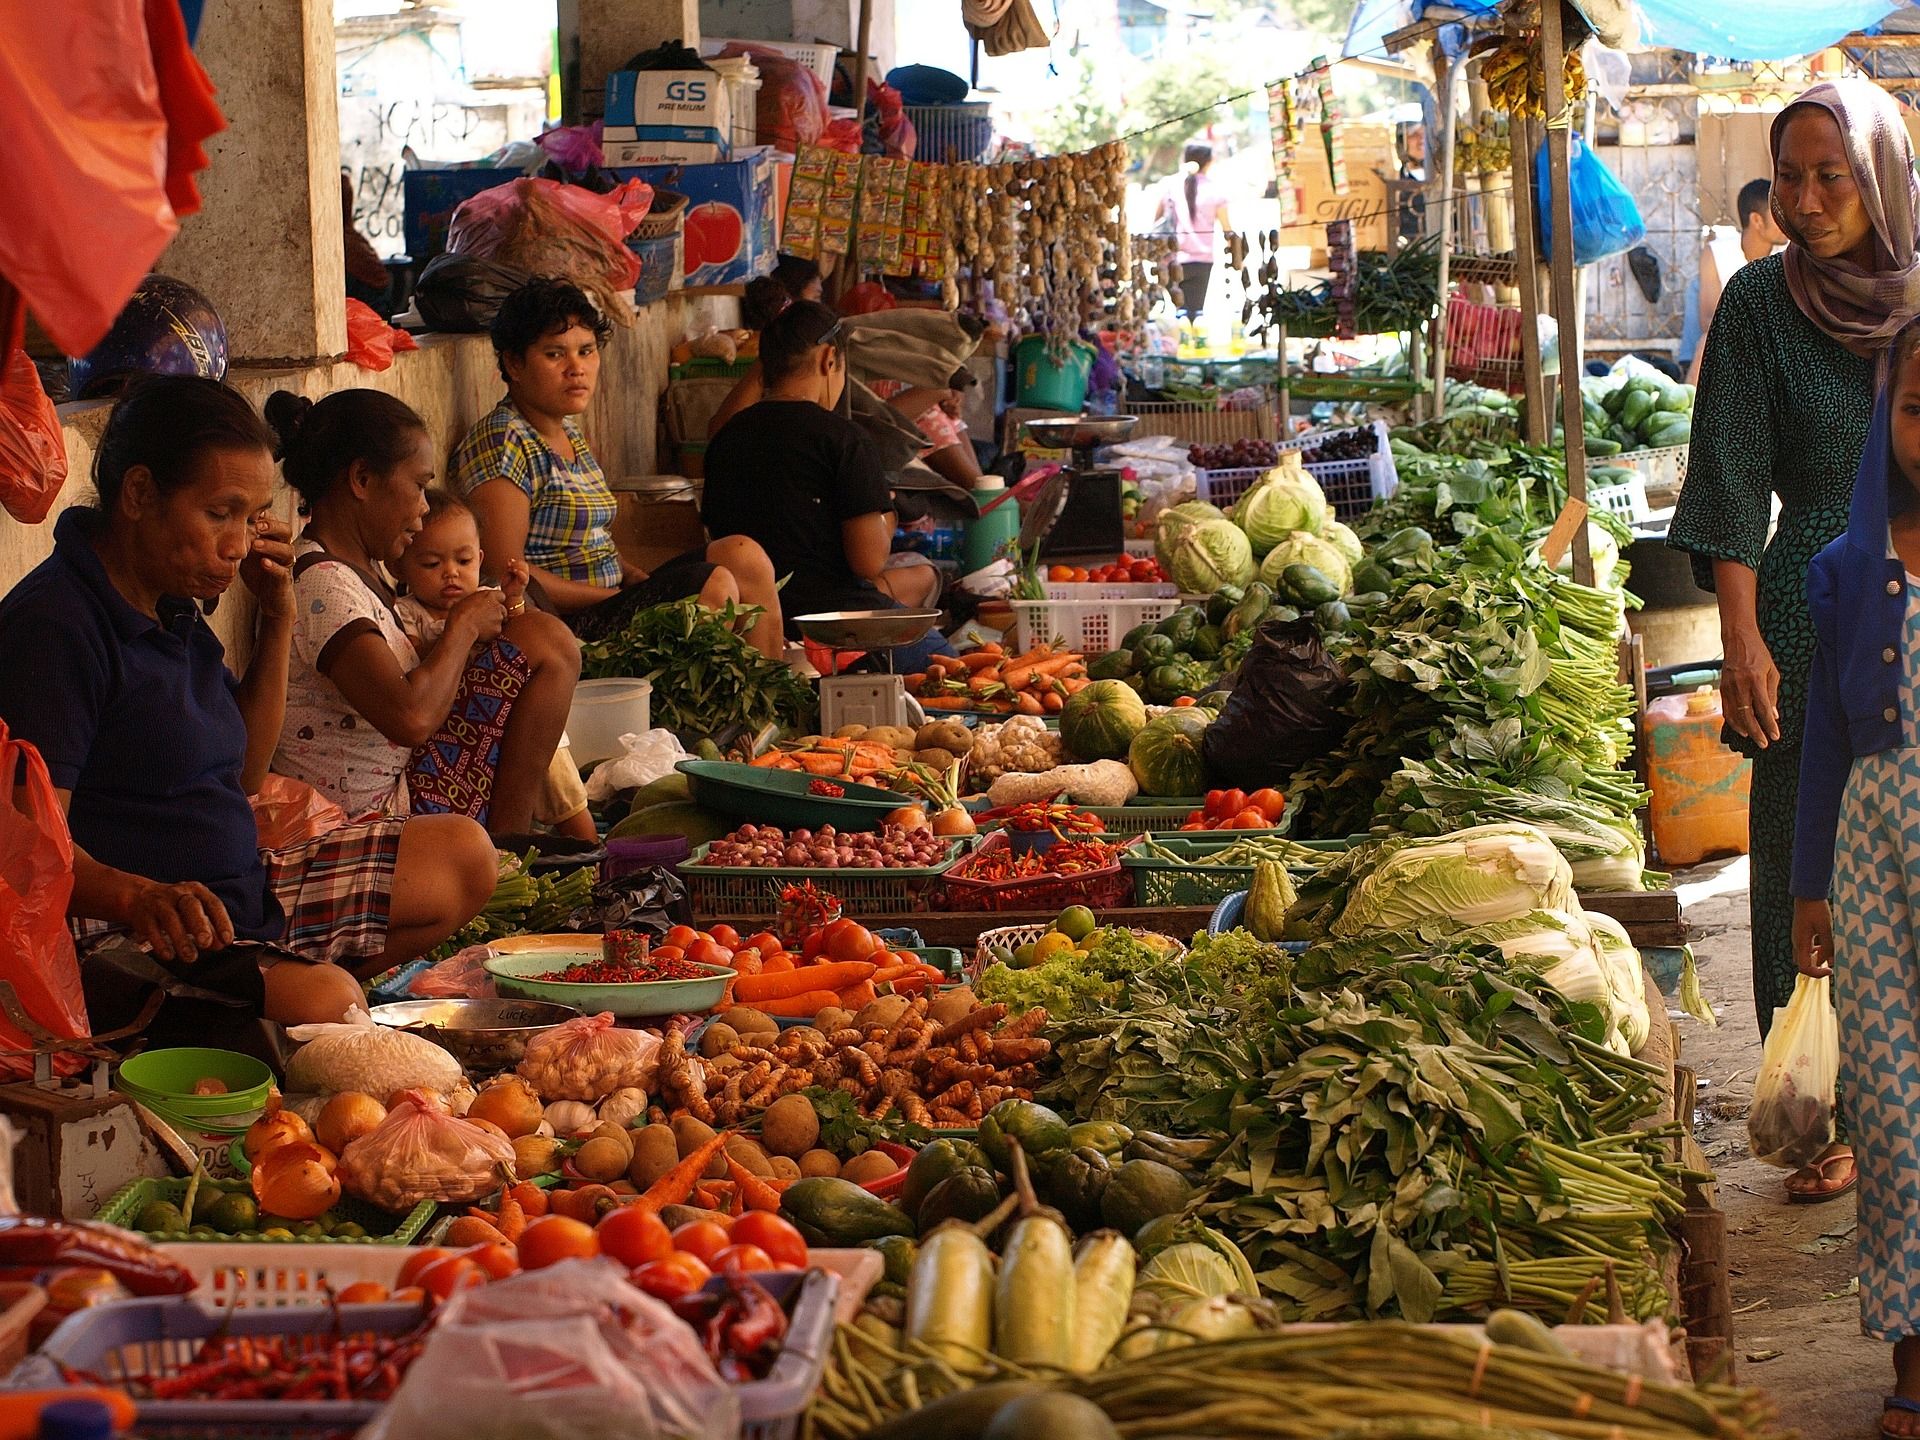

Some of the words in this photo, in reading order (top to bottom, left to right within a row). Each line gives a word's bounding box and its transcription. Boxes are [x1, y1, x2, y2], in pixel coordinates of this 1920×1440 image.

[664, 80, 707, 101] GS
[657, 102, 706, 112] PREMIUM
[473, 685, 503, 698] GUESS
[420, 791, 451, 807] GUESS
